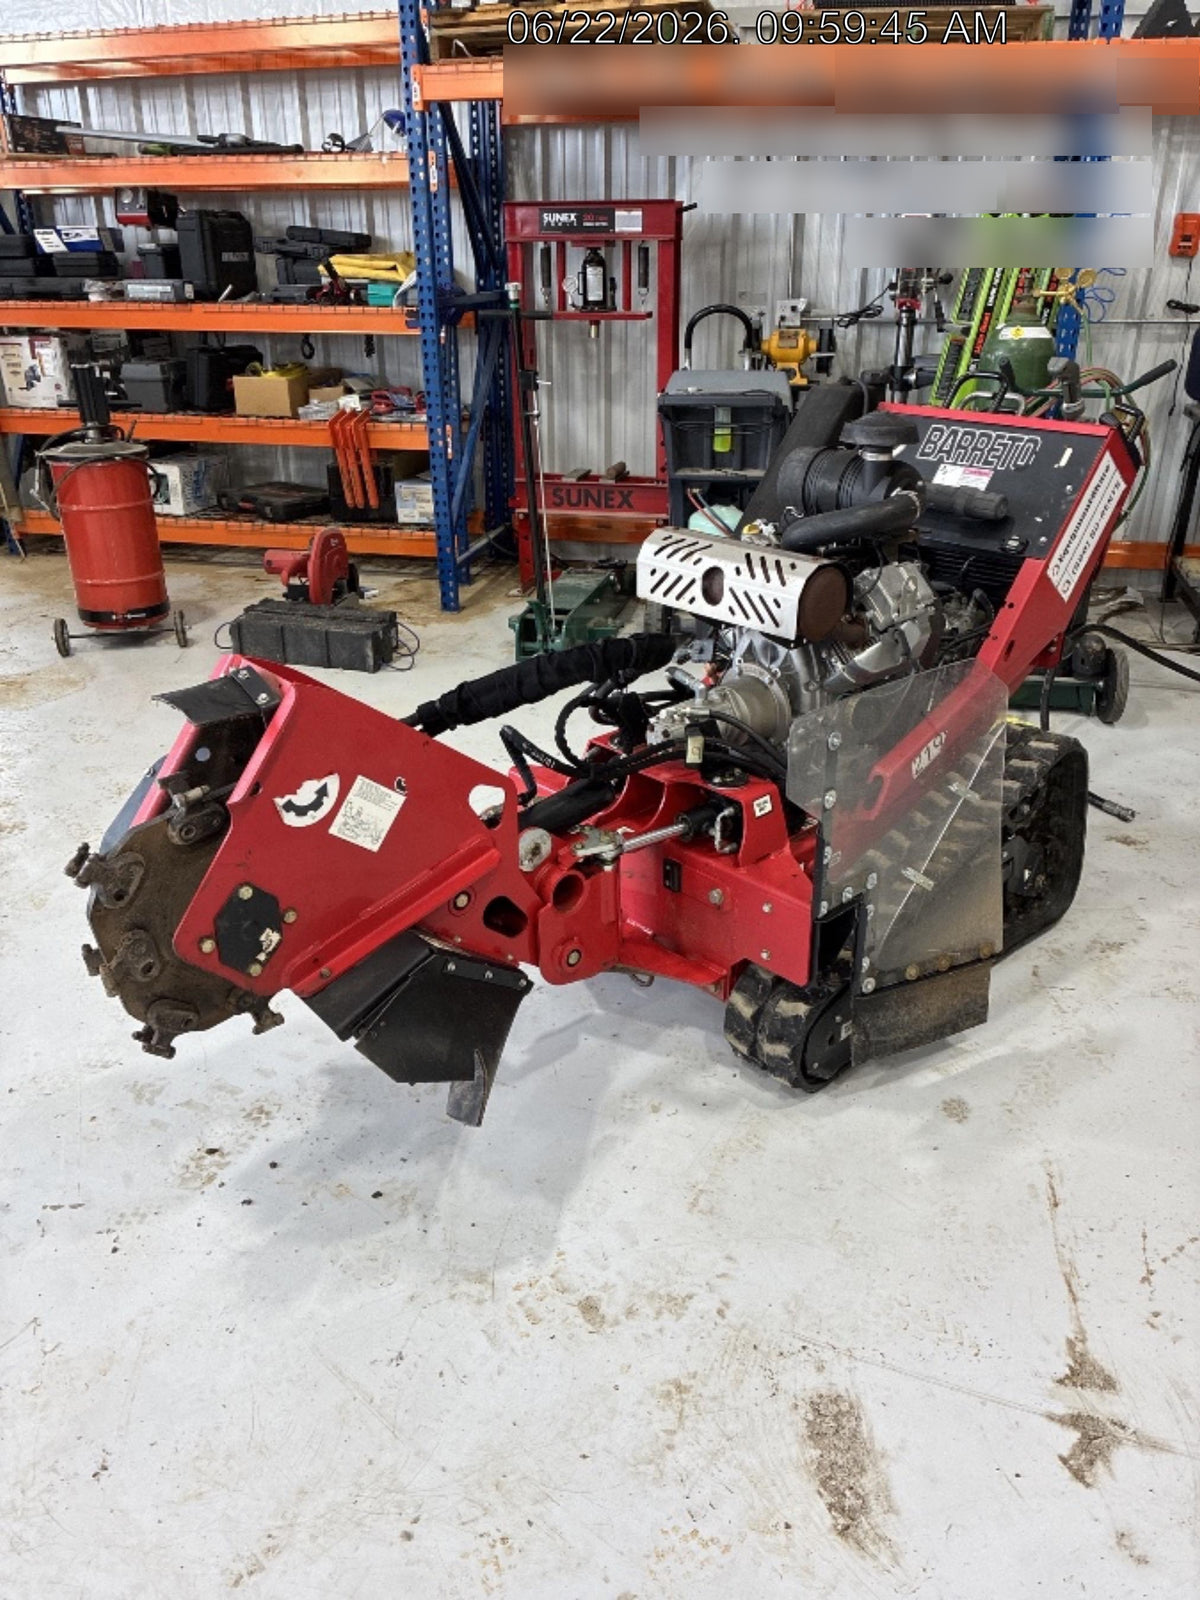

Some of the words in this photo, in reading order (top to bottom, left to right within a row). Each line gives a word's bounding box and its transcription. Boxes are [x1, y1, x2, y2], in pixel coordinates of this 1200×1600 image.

[543, 212, 577, 223] SUNEX
[915, 424, 1043, 471] BARRETO
[552, 486, 634, 509] SUNEX
